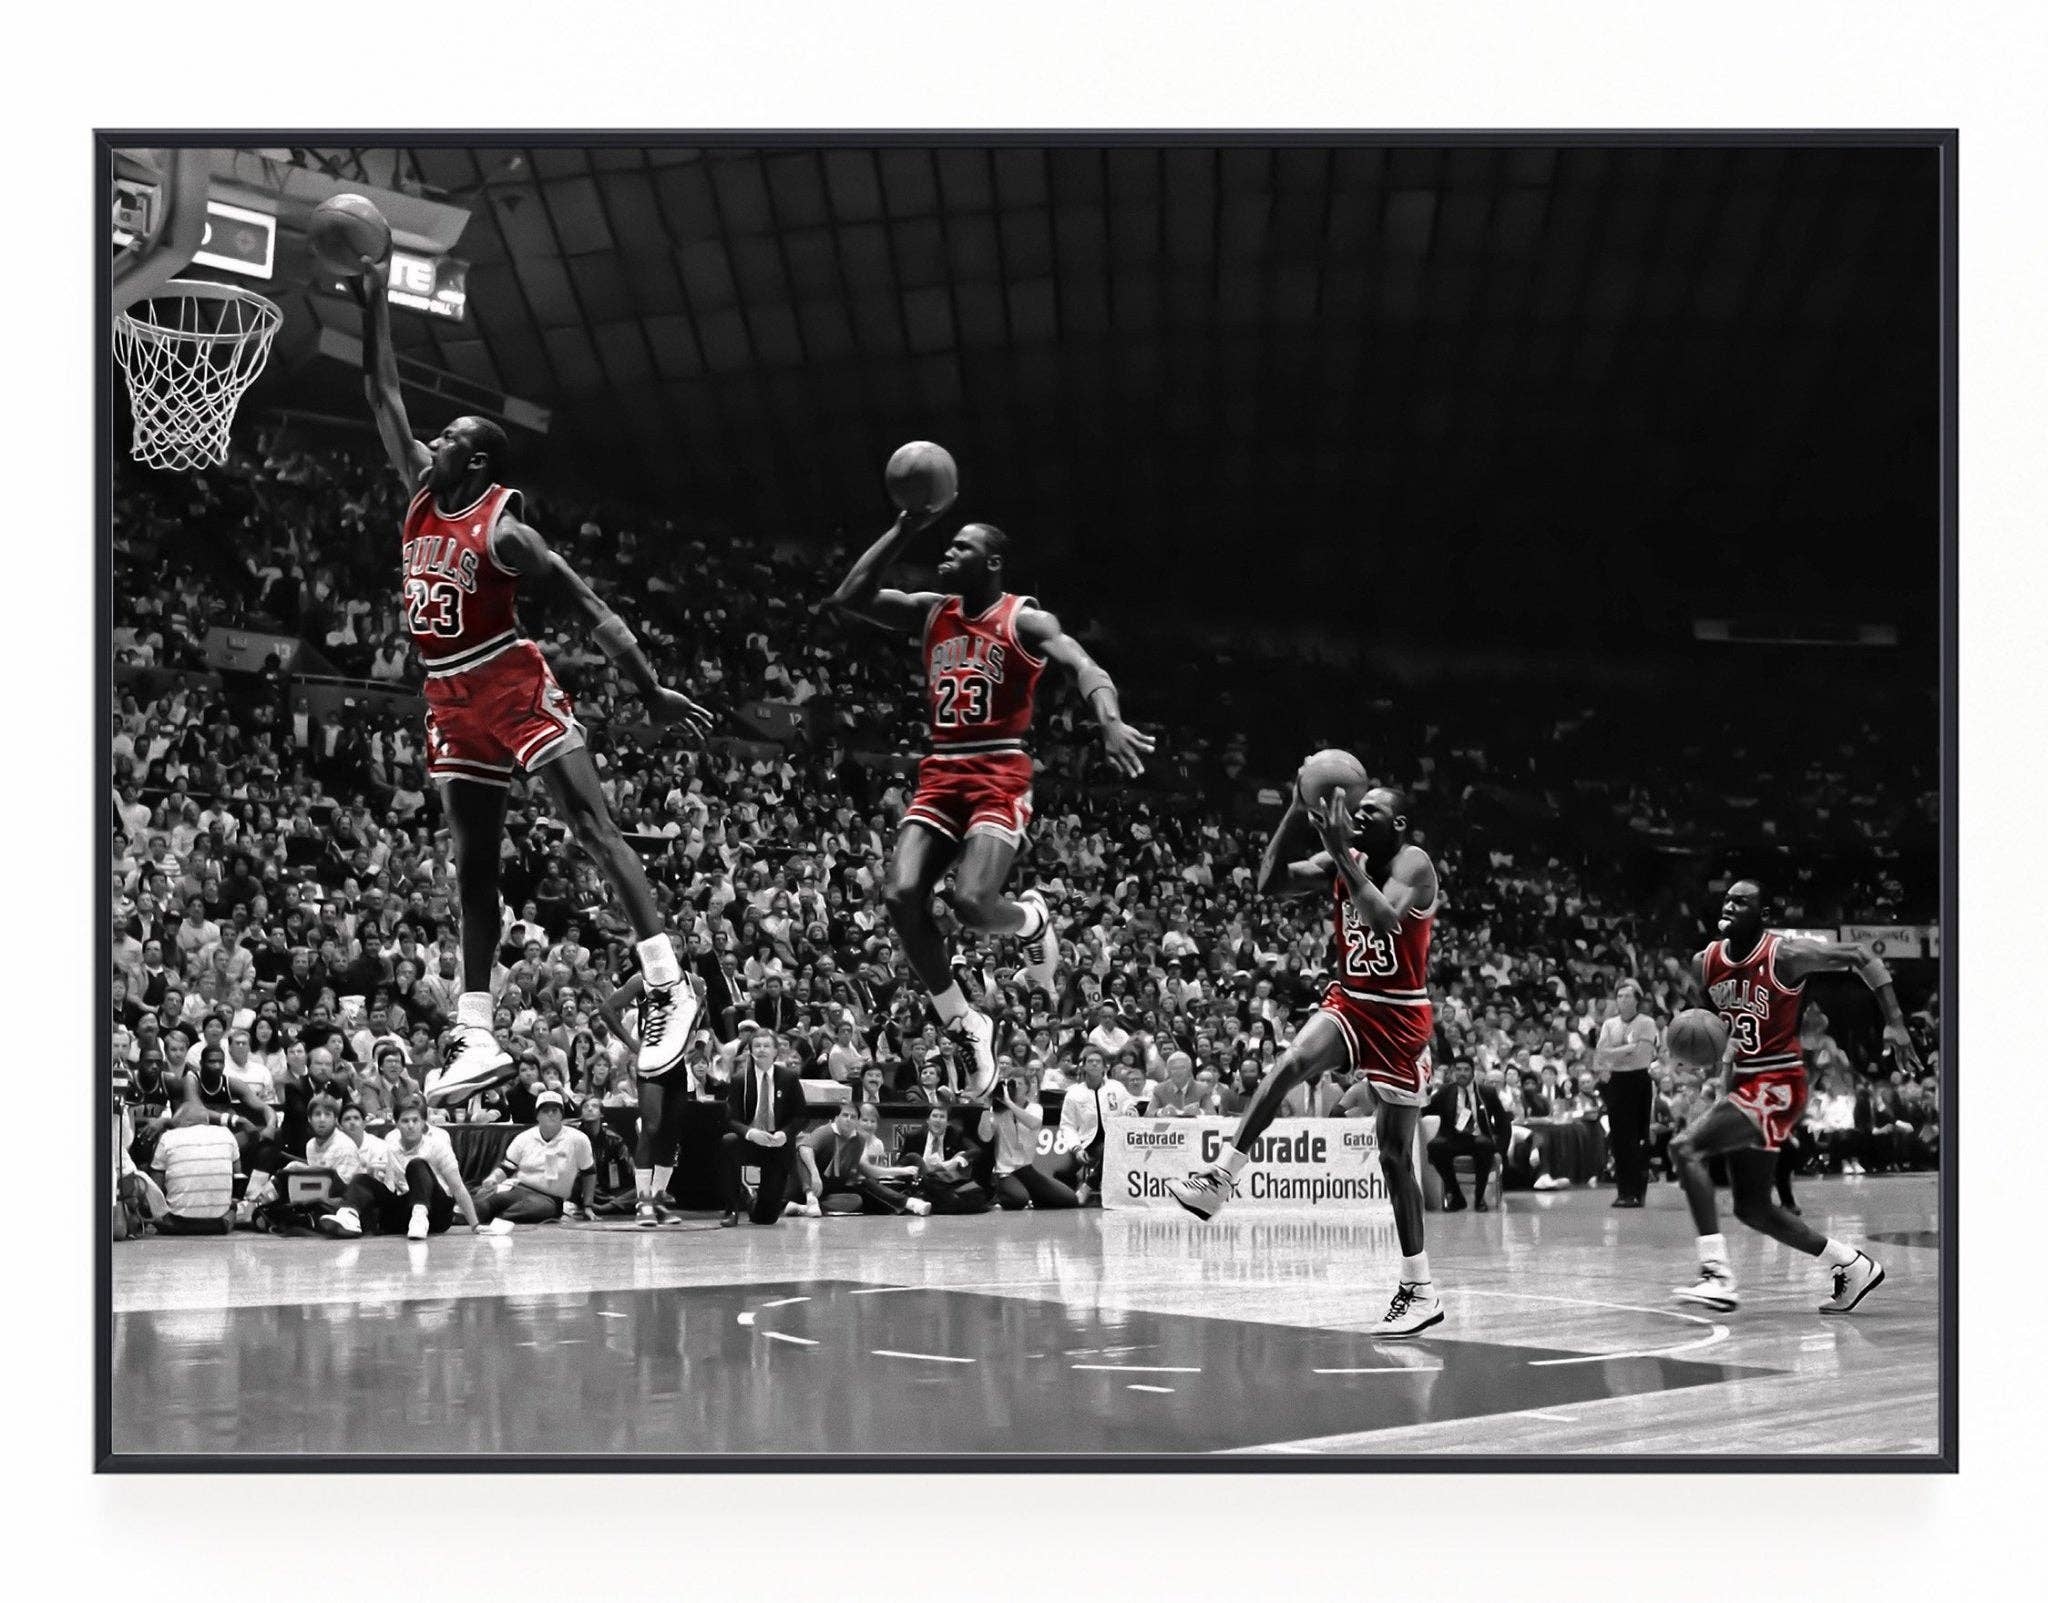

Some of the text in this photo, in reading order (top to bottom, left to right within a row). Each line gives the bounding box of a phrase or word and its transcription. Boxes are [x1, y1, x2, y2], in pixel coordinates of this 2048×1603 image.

[405, 579, 464, 638] 23
[930, 635, 1005, 684] BULLS
[935, 675, 992, 727] 23
[1345, 930, 1398, 976] 23
[1127, 1131, 1185, 1146] Gatorade
[1202, 1129, 1327, 1163] Gorade
